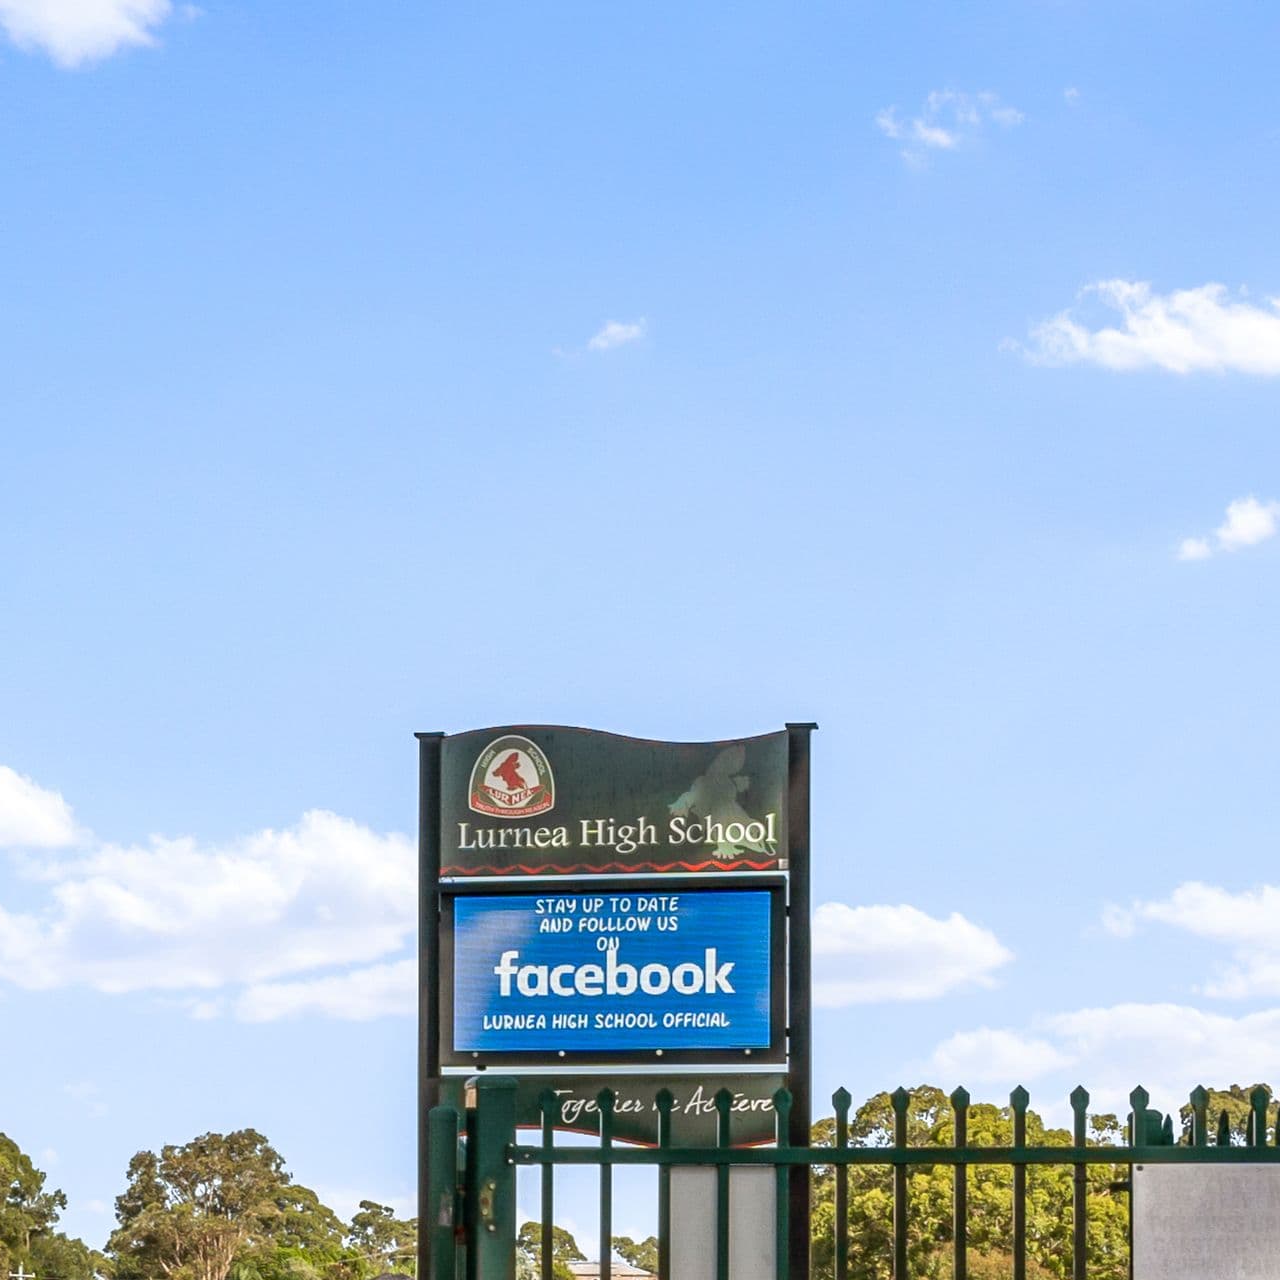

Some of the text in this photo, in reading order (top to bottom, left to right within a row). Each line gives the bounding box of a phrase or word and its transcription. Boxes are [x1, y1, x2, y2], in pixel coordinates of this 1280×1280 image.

[457, 813, 777, 854] Lurnea High School
[535, 896, 679, 914] STAY UP TO DATE
[539, 916, 679, 933] AND FOLLLOW US
[596, 936, 620, 952] ON
[494, 948, 736, 997] facebook
[483, 1012, 730, 1030] LURNEA HIGH SCHOOL OFFICIAL
[683, 1085, 775, 1116] Acieve
